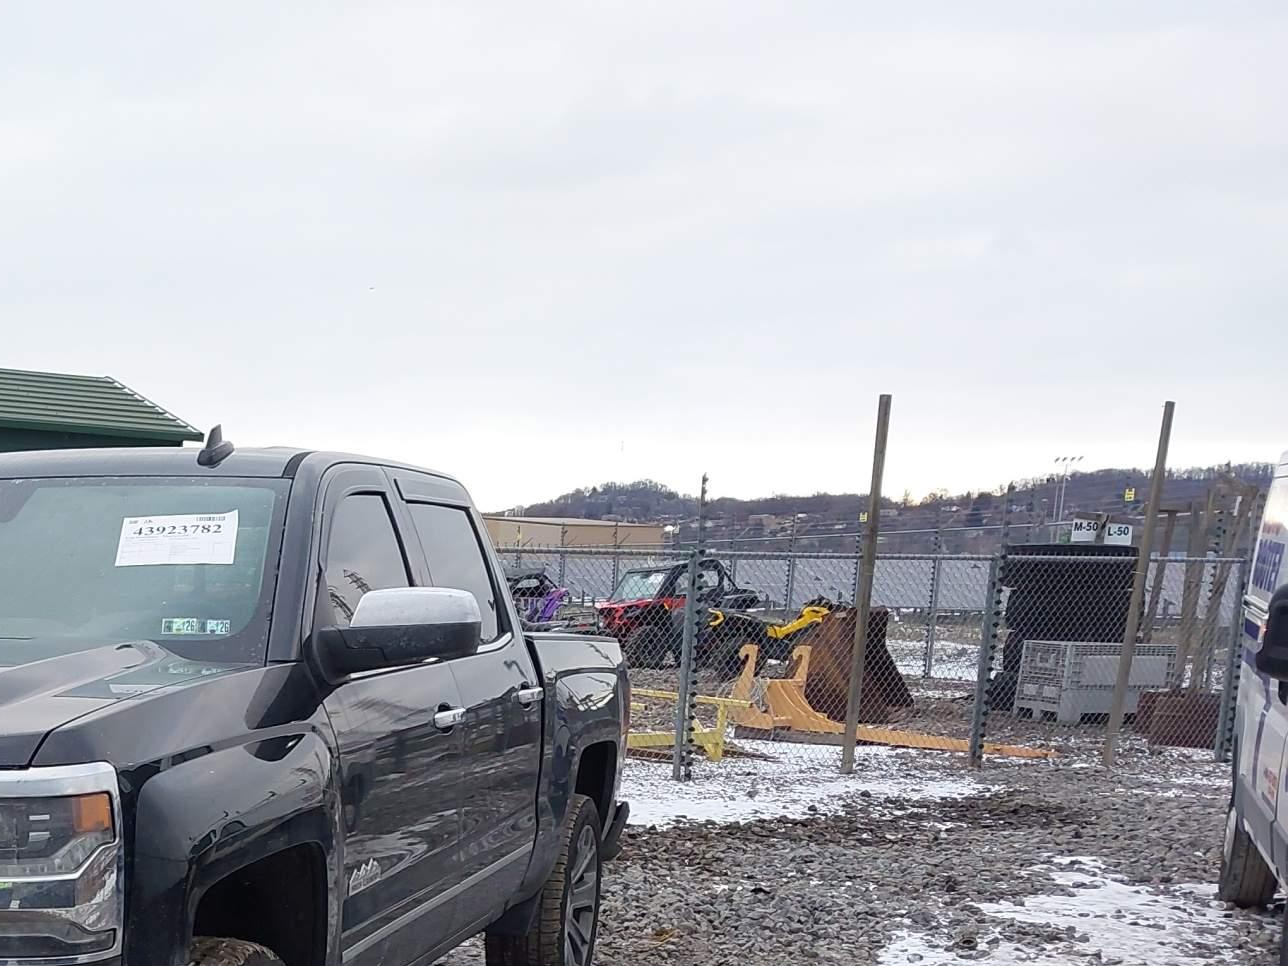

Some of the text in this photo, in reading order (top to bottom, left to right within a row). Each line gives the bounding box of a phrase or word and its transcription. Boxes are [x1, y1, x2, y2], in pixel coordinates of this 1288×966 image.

[132, 524, 223, 536] 43923782
[1073, 521, 1099, 532] M-50
[1107, 526, 1130, 537] L-50
